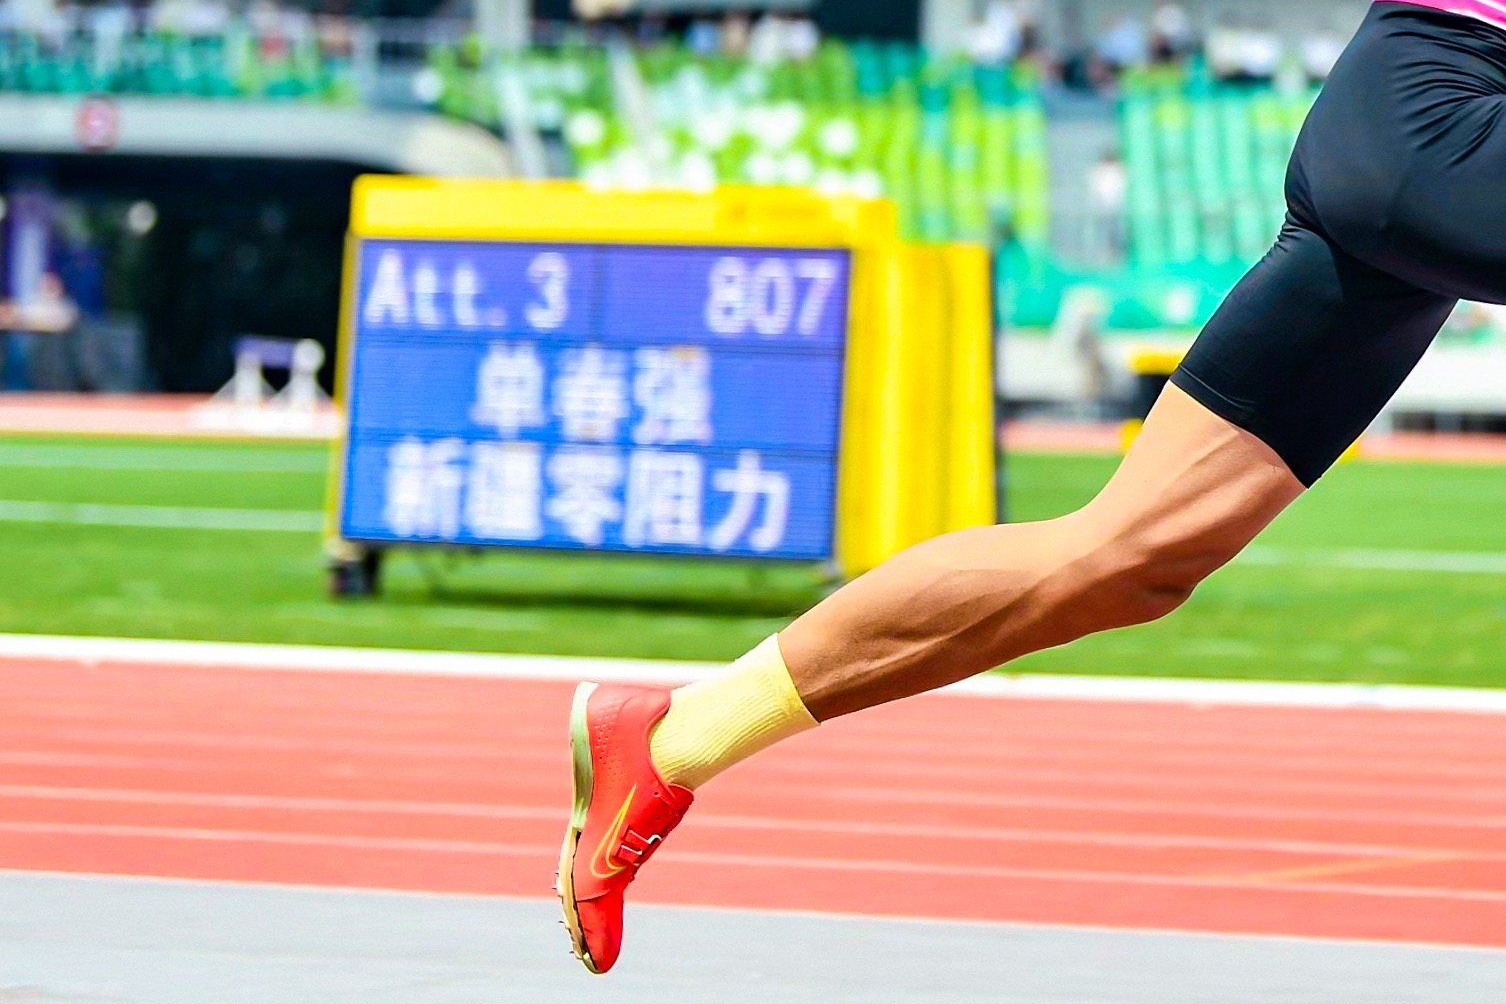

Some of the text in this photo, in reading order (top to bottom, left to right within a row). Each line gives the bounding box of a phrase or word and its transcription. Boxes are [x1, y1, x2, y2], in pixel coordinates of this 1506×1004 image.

[363, 248, 571, 330] Att. 3
[705, 254, 837, 336] 807
[469, 340, 714, 445] 单春强
[384, 436, 791, 552] 新疆零阻力
